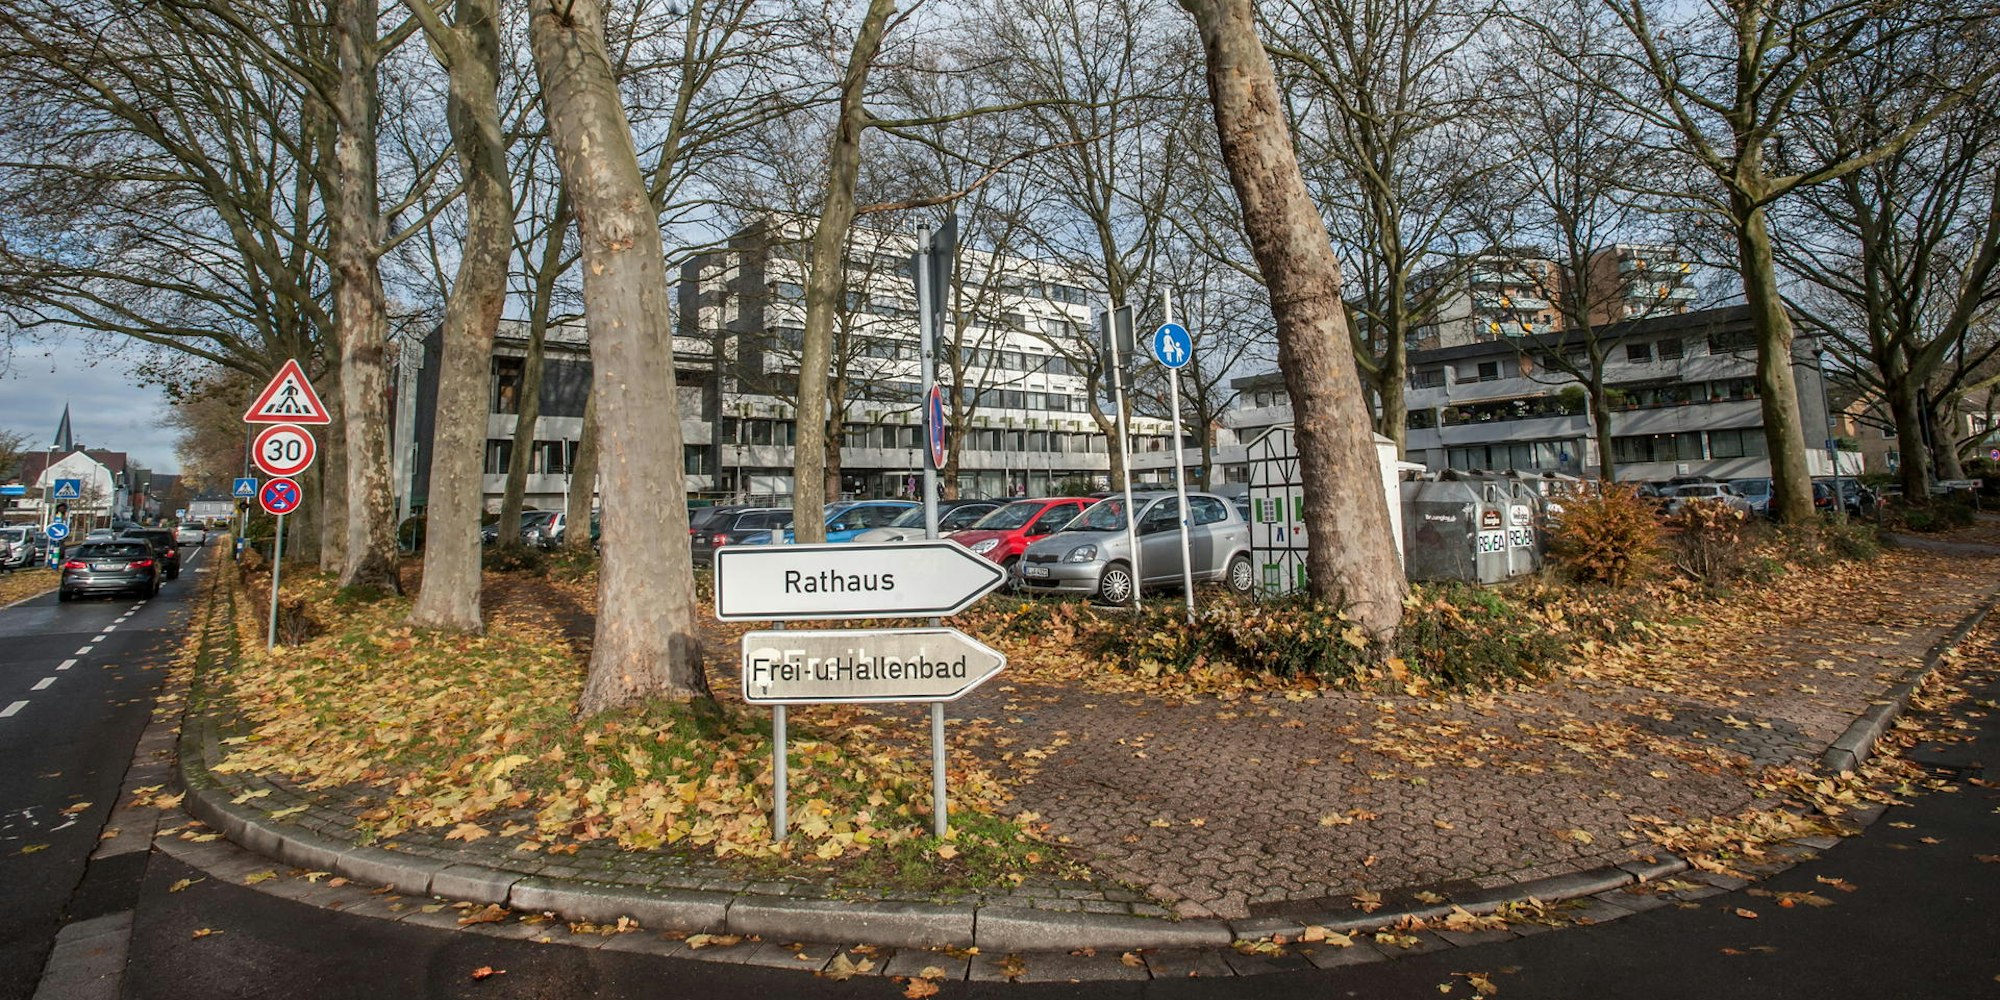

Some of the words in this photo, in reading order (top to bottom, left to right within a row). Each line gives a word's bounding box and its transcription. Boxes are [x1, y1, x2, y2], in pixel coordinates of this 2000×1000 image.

[267, 439, 301, 461] 30
[1479, 535, 1504, 552] REVEA
[1509, 530, 1533, 546] REVEA
[785, 570, 894, 593] Rathaus
